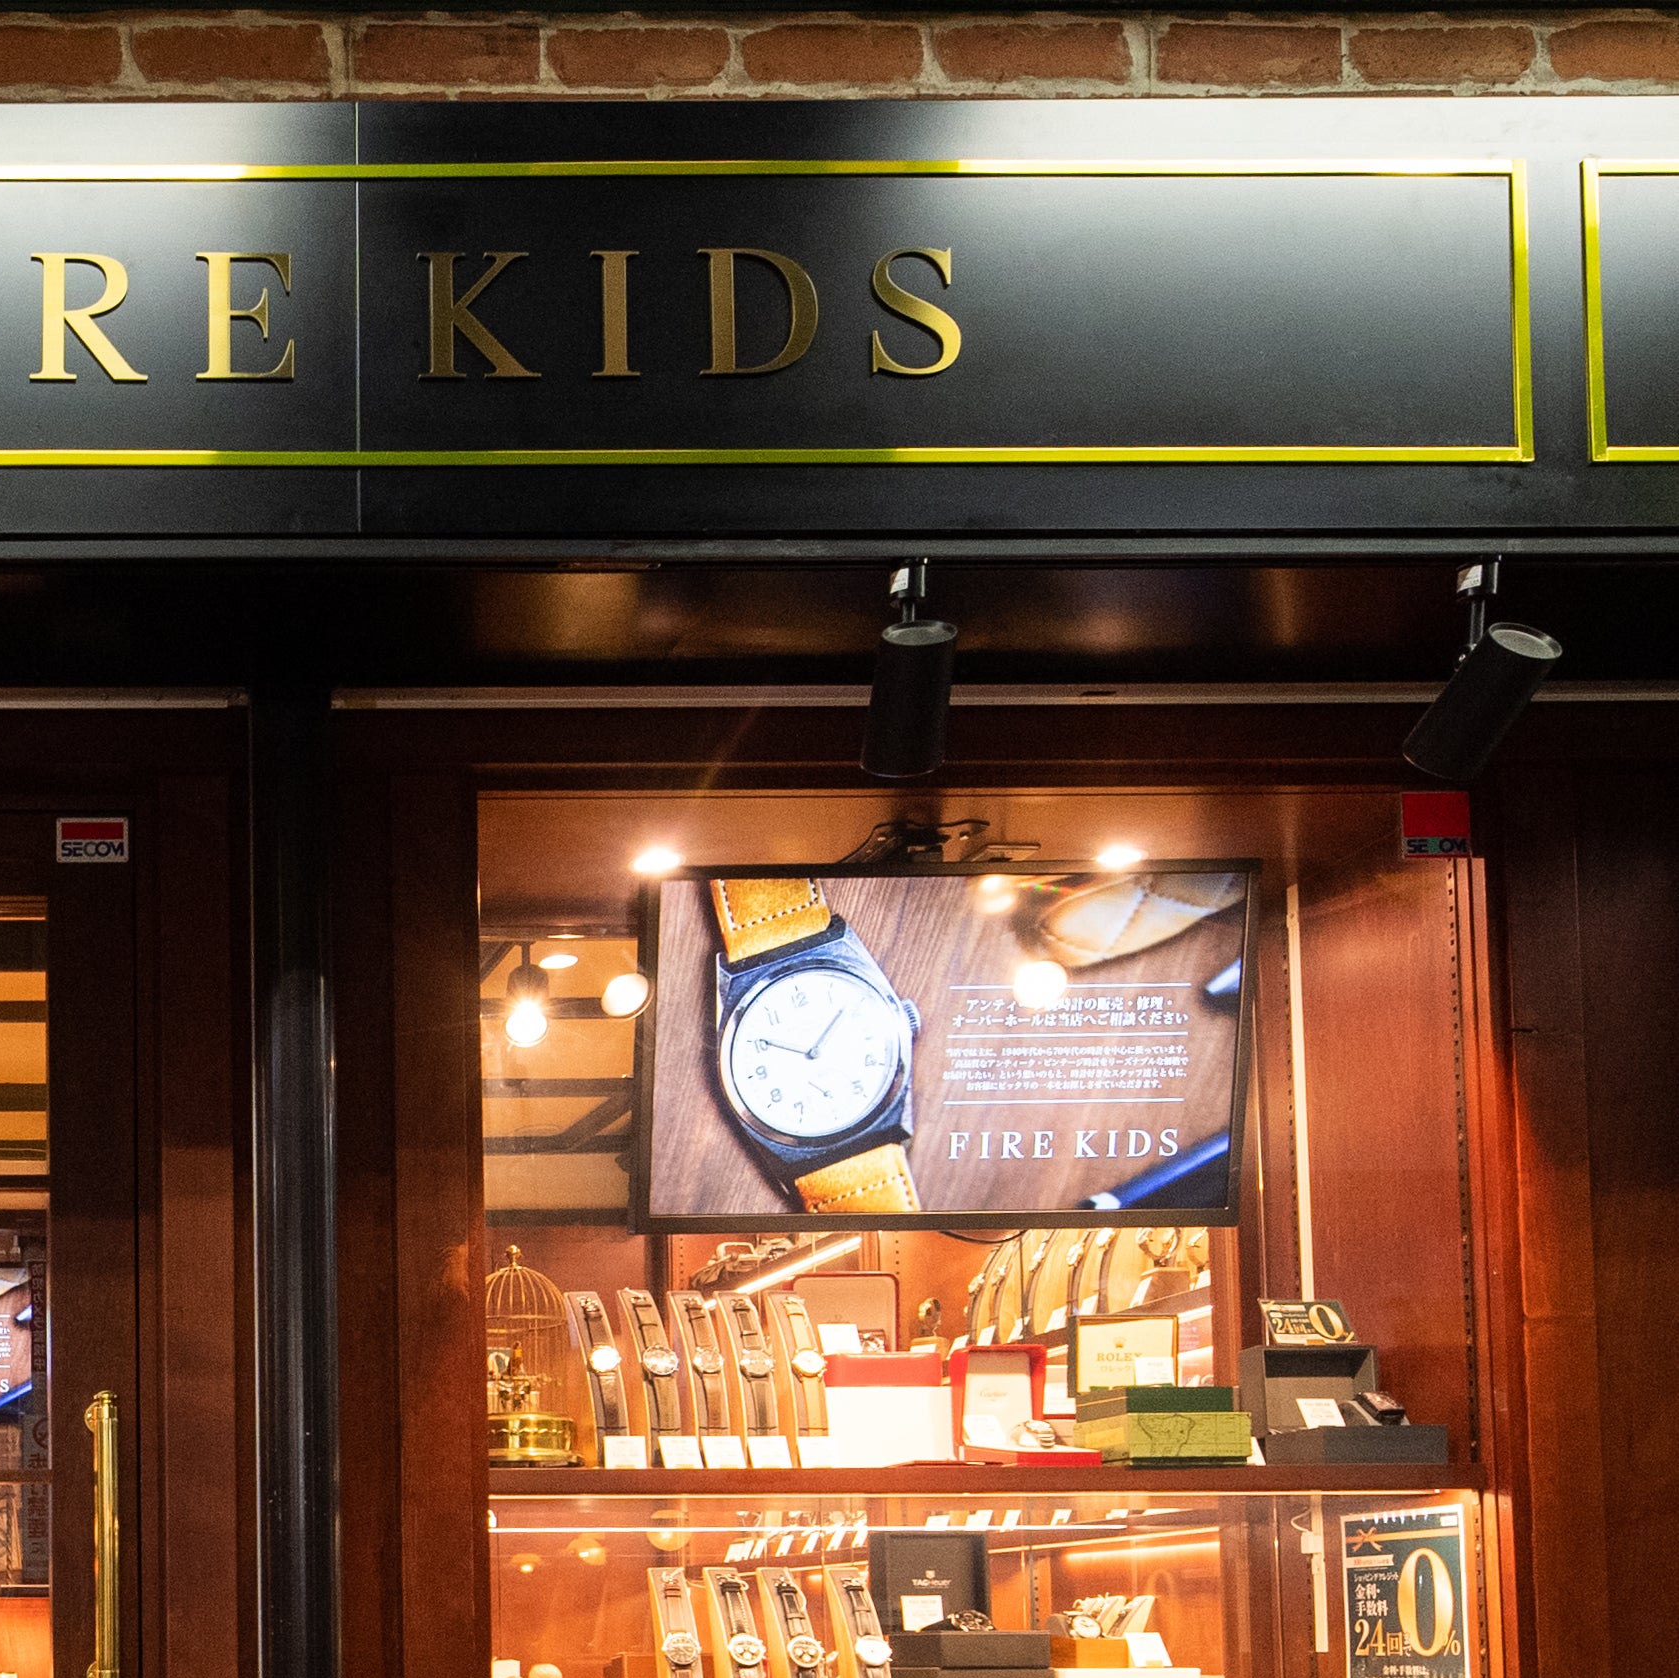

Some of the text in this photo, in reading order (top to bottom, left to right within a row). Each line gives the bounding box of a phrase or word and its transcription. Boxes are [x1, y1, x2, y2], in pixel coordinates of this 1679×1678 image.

[416, 245, 964, 381] KIDS
[61, 841, 125, 857] SECOM
[1406, 838, 1467, 854] SECOM
[948, 1128, 1180, 1160] FIRE KIDS
[1355, 1600, 1389, 1617] 手数料
